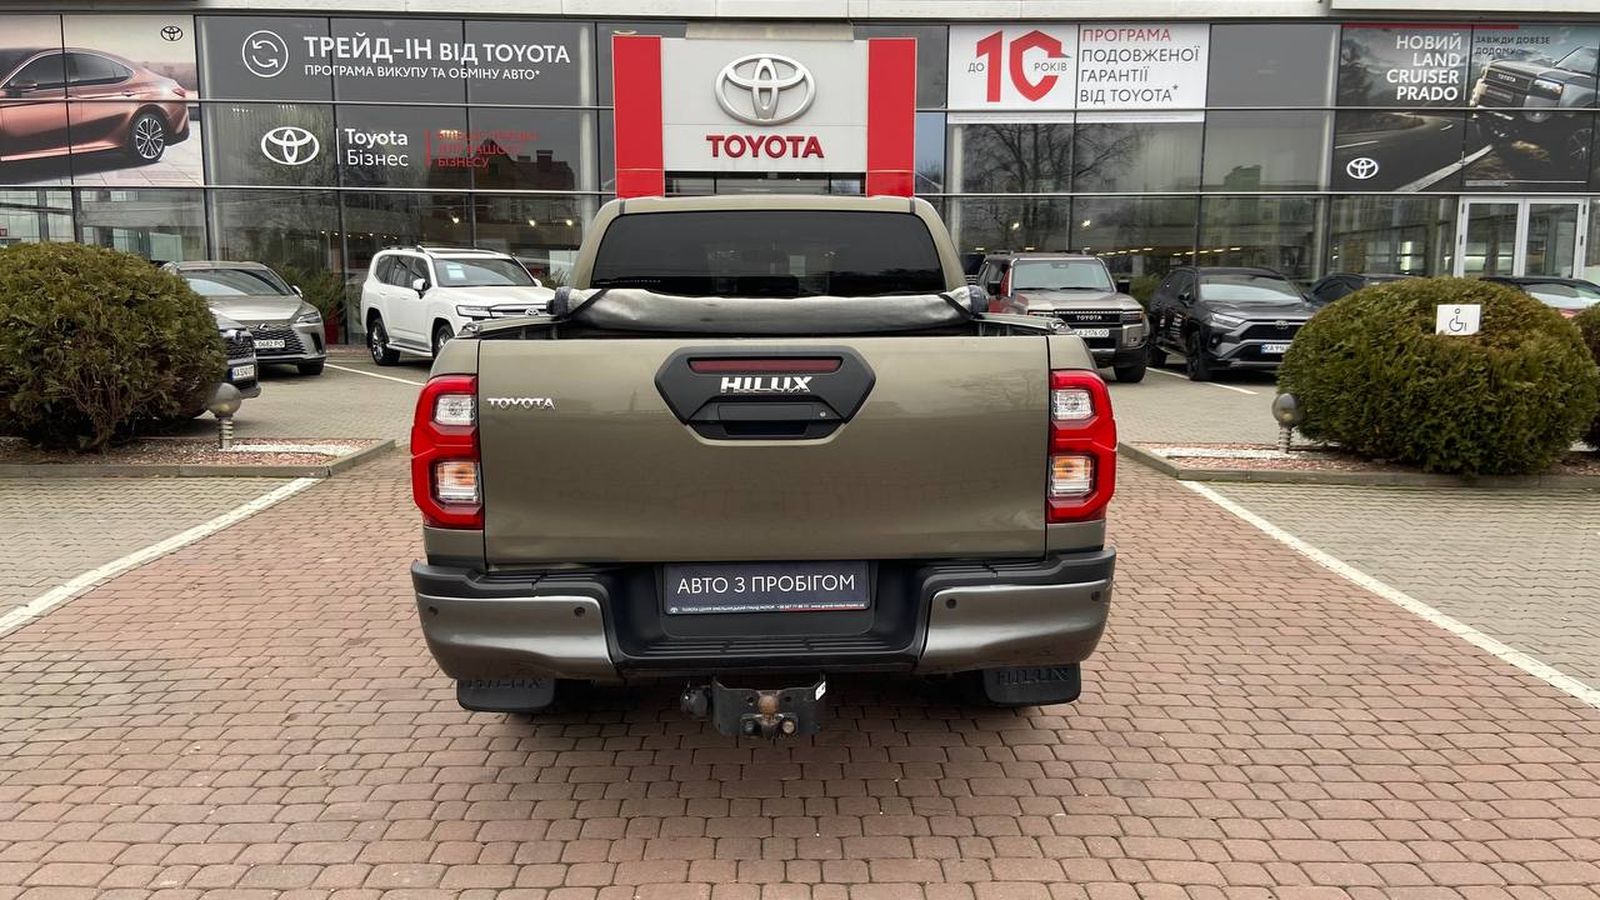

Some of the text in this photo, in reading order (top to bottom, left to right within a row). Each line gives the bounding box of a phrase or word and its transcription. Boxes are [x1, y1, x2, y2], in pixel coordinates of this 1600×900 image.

[1083, 29, 1171, 41] ПРОГРАМА
[1396, 32, 1461, 50] НОВИЙ
[303, 32, 570, 65] ТРЕЙД-ІН ВІД TOYOTA
[1082, 46, 1200, 63] ПОДОВЖЕНОЇ
[968, 62, 985, 72] ДО
[1034, 62, 1067, 71] РОКІВ
[1413, 53, 1461, 66] LAND
[305, 64, 374, 76] ПРОГРАМА
[377, 67, 428, 78] ВИКУПУ
[430, 67, 446, 78] ТА
[448, 68, 500, 79] ОБМІНУ
[1080, 66, 1149, 82] ГАРАНТІЇ
[1386, 69, 1459, 84] CRUISER
[1080, 88, 1106, 104] ВІД
[1396, 86, 1458, 101] PRADO
[344, 128, 408, 149] Toyota
[706, 134, 824, 158] TOYOTA
[347, 149, 409, 166] Бізнес
[438, 156, 489, 168] БІЗНЕСУ
[720, 376, 813, 394] HILUX
[487, 398, 555, 410] TOYOTA
[677, 574, 855, 594] АВТО З ПРОБІГОМ
